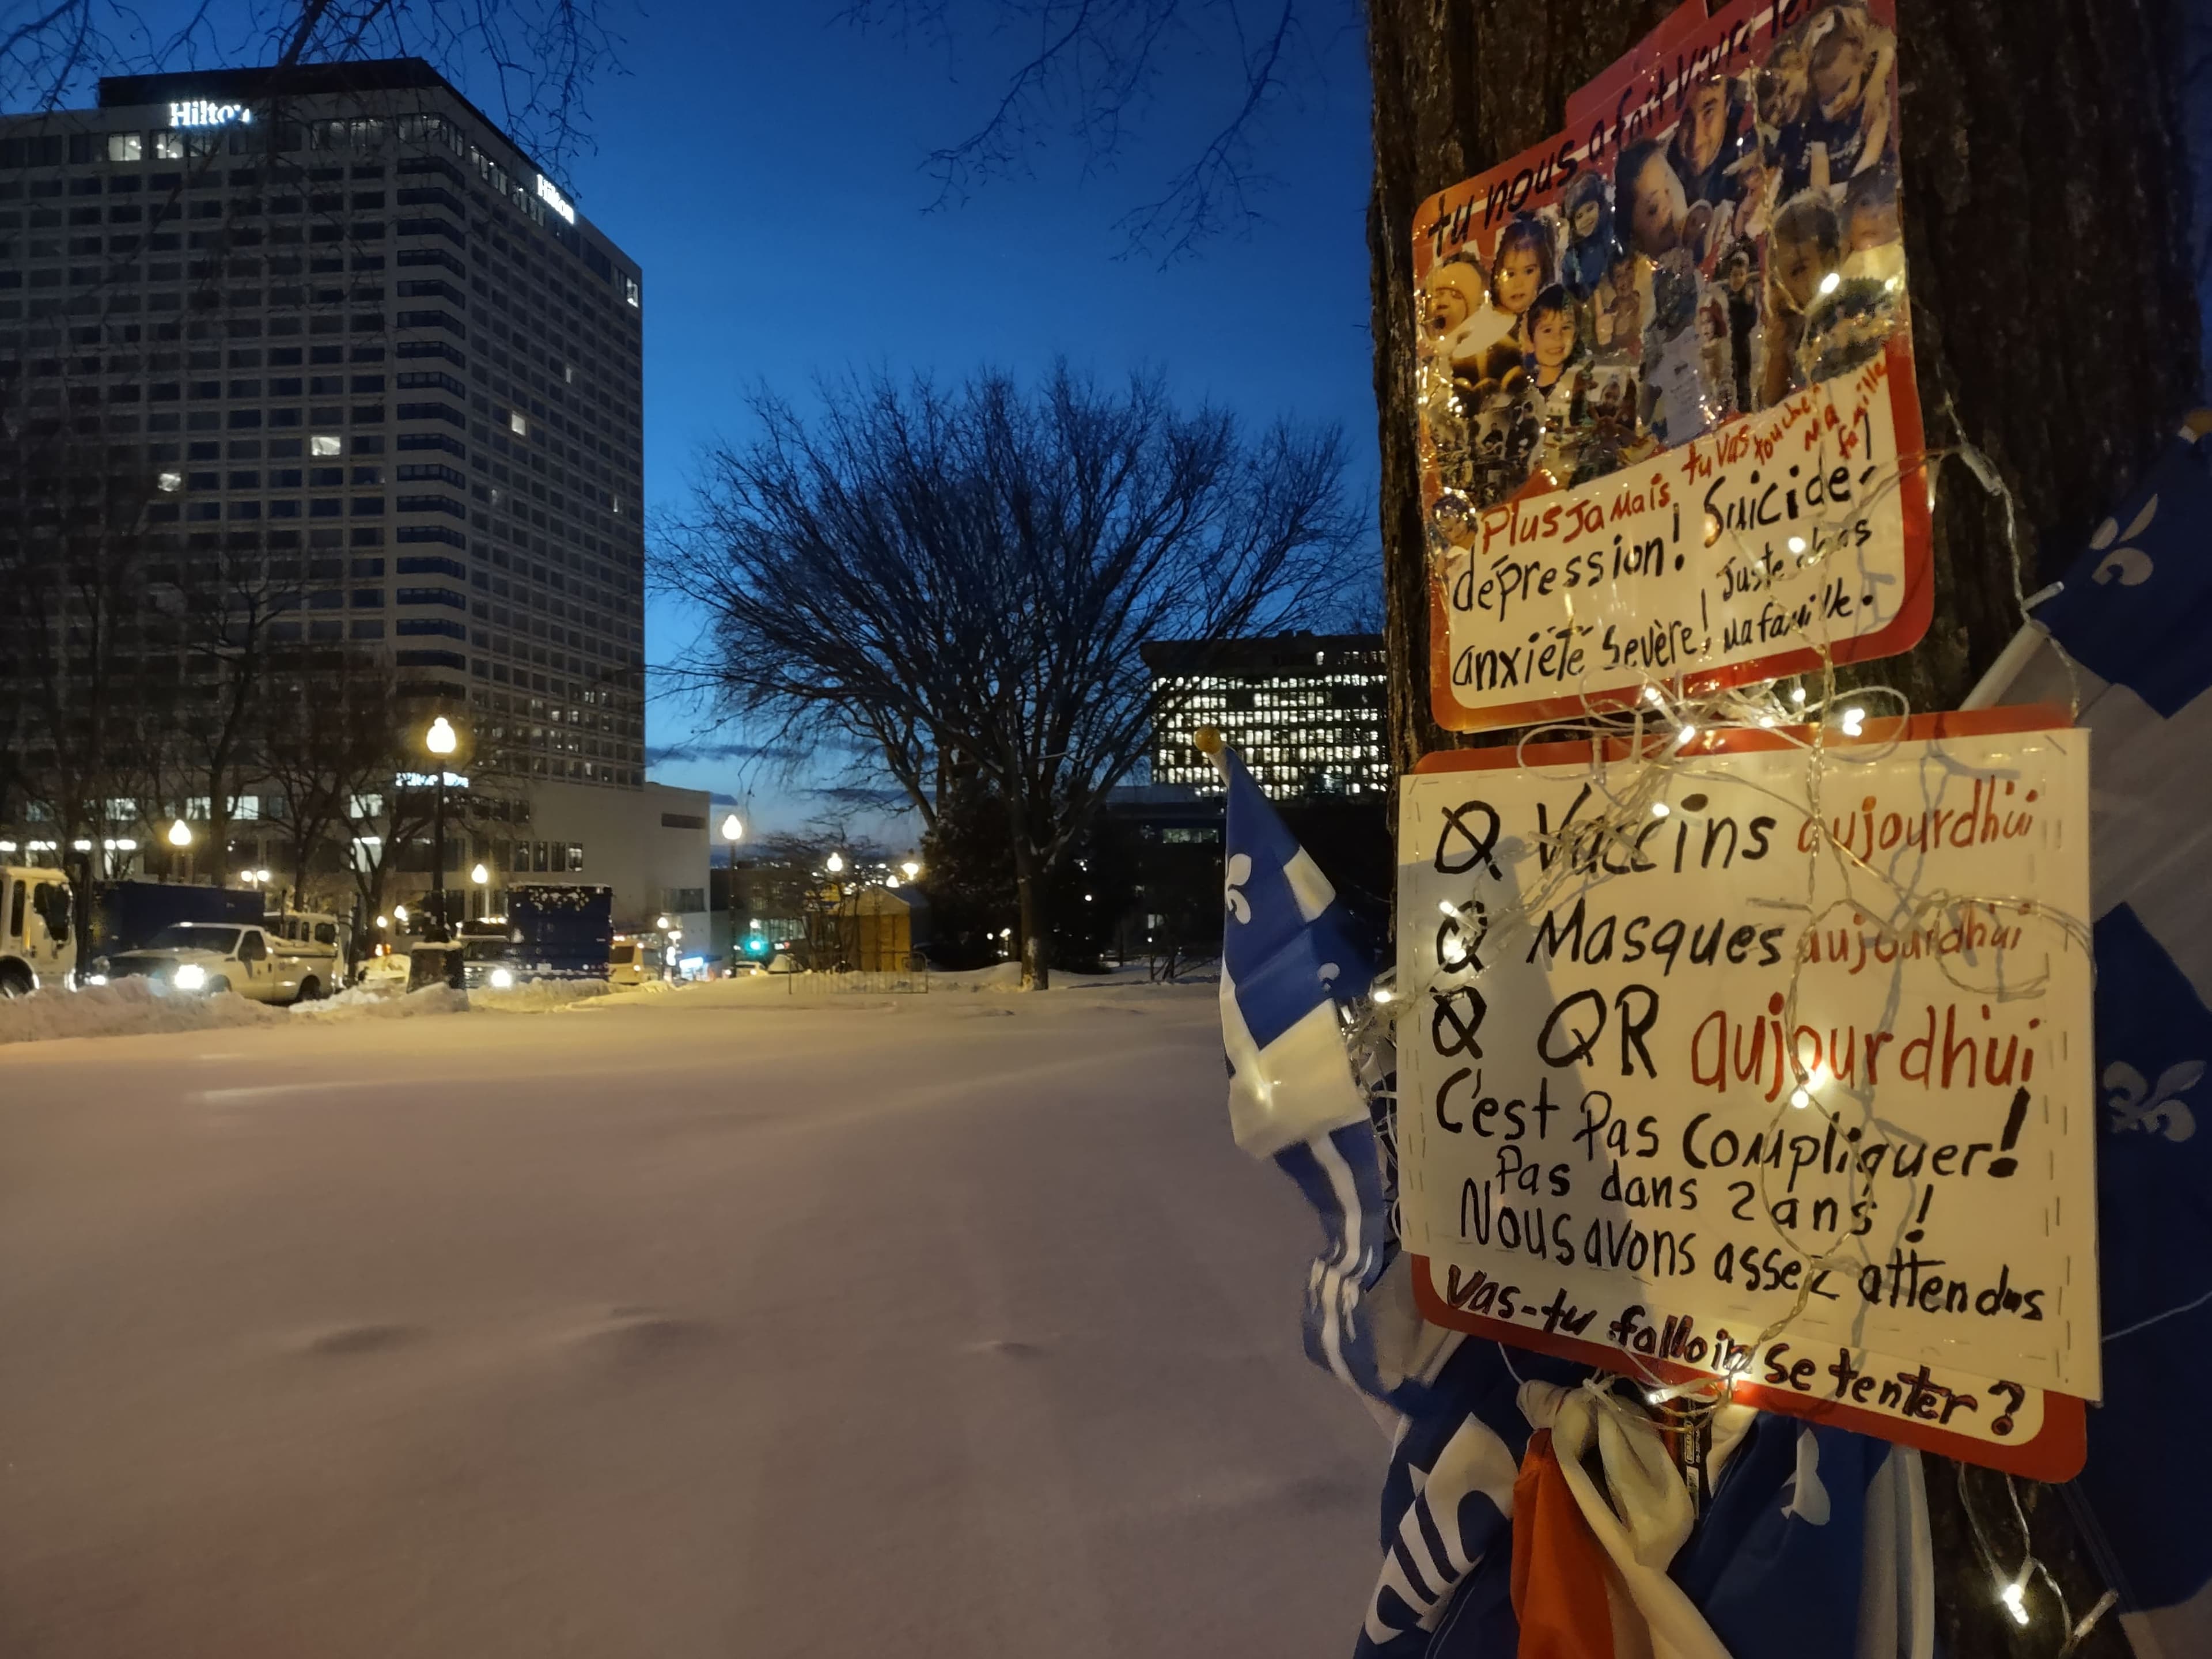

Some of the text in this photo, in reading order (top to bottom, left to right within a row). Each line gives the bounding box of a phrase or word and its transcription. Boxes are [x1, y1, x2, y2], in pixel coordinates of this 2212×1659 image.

[1428, 194, 1474, 257] tu
[1484, 140, 1577, 230] nous
[1589, 120, 1604, 161] a
[1481, 500, 1563, 554] Plus
[1681, 442, 1711, 486] tu
[1536, 782, 1777, 874] Vaccins
[1526, 897, 1785, 977] Masques
[1537, 984, 1659, 1078] QR
[1436, 1067, 1560, 1141] C'est
[1572, 1090, 1659, 1161] Pas
[1496, 1145, 1571, 1196] Pas
[1601, 1159, 1698, 1210] dans
[1461, 1177, 1575, 1266] Nous
[1584, 1218, 1696, 1277] avons
